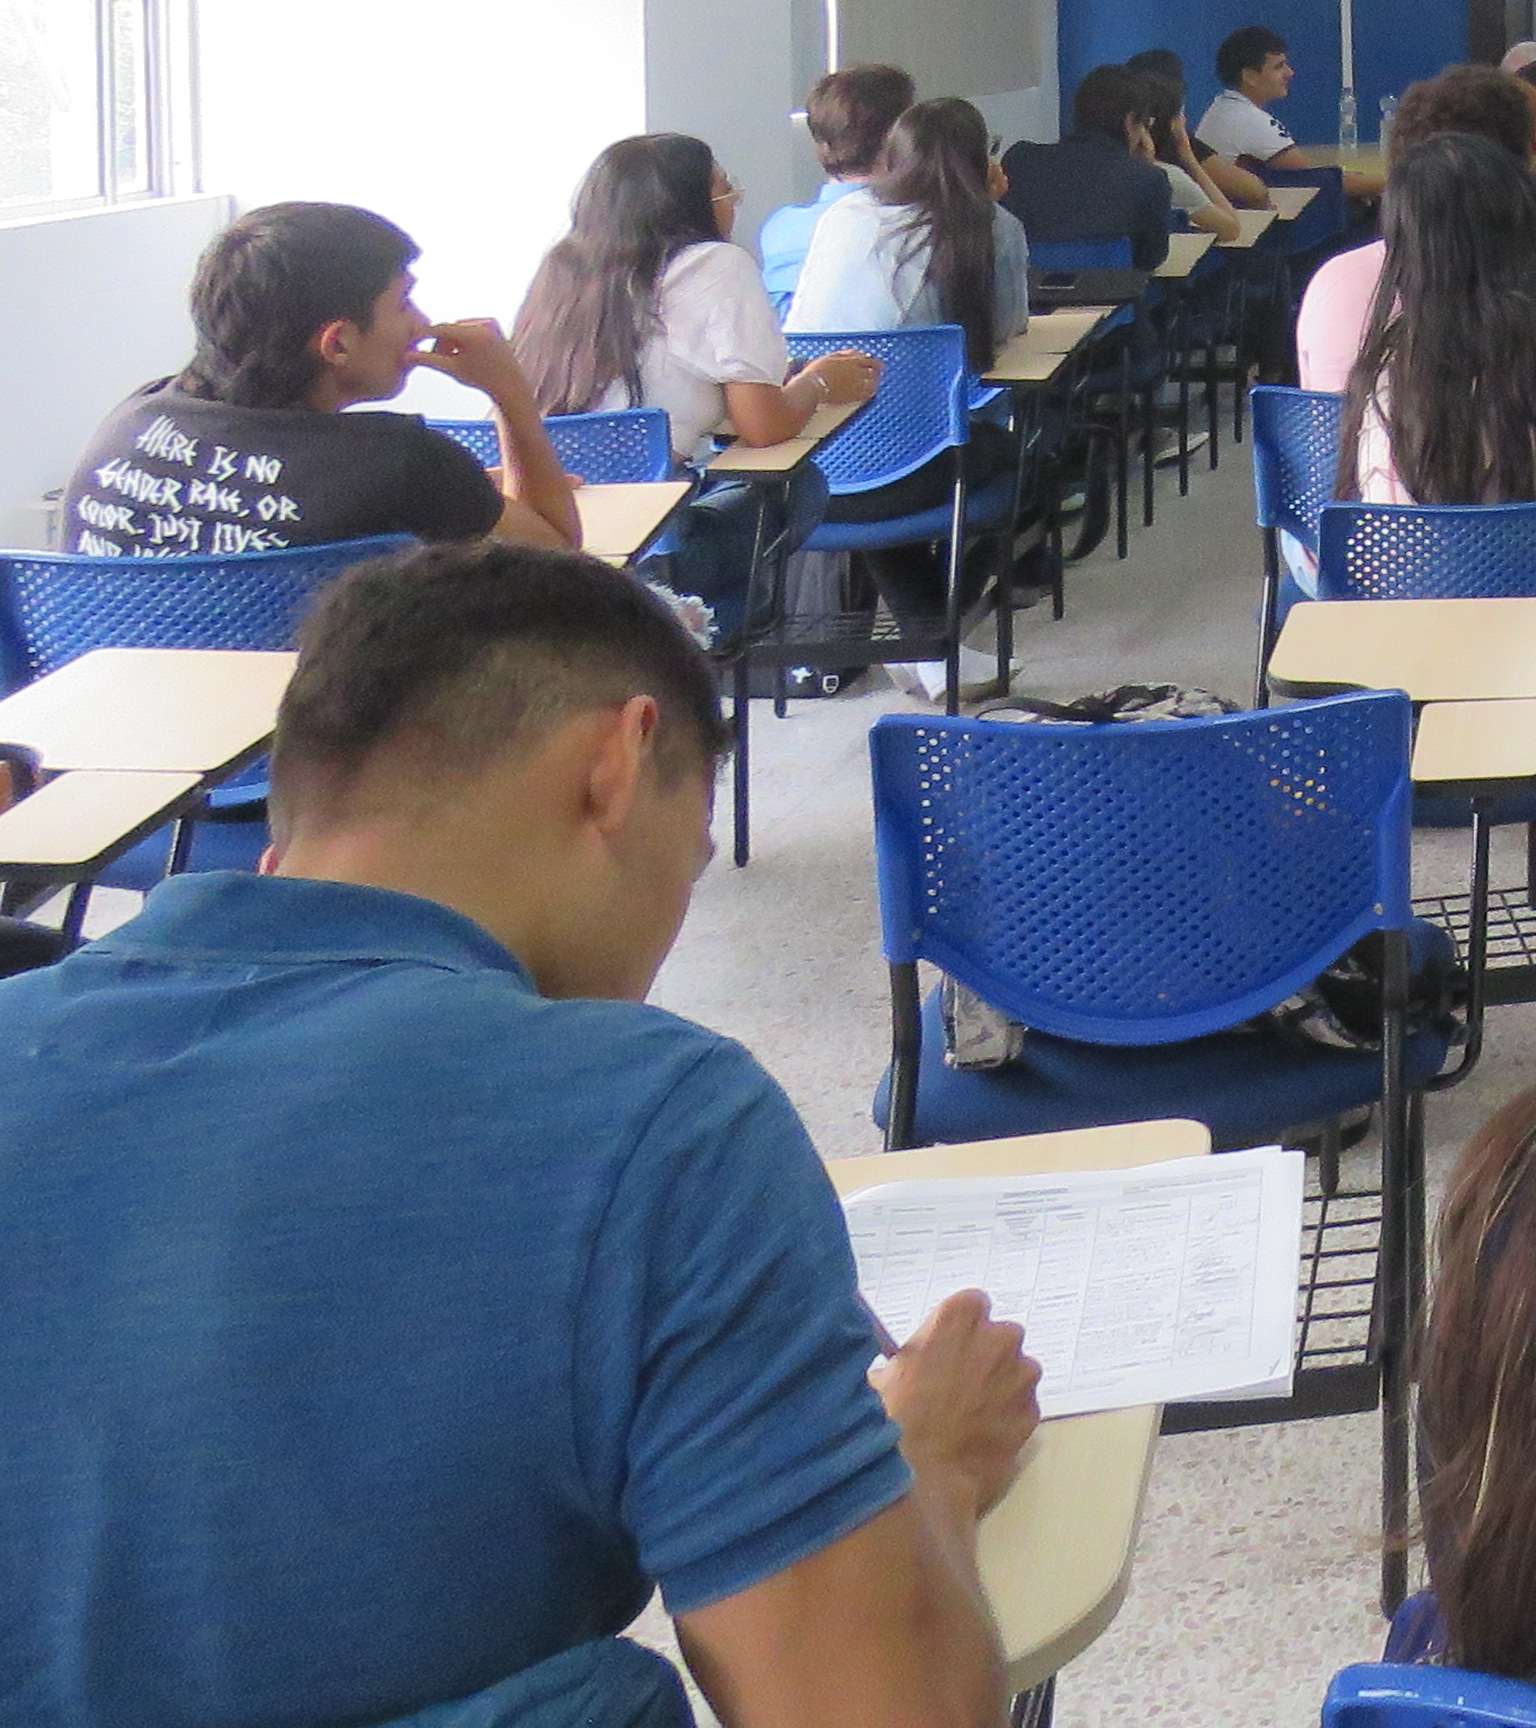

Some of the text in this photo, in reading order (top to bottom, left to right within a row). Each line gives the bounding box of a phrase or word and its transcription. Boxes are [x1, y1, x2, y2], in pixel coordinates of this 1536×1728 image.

[136, 415, 284, 485] THERE IS NO
[189, 478, 250, 518] RACE,
[256, 494, 301, 521] OR
[149, 513, 204, 551] JUST
